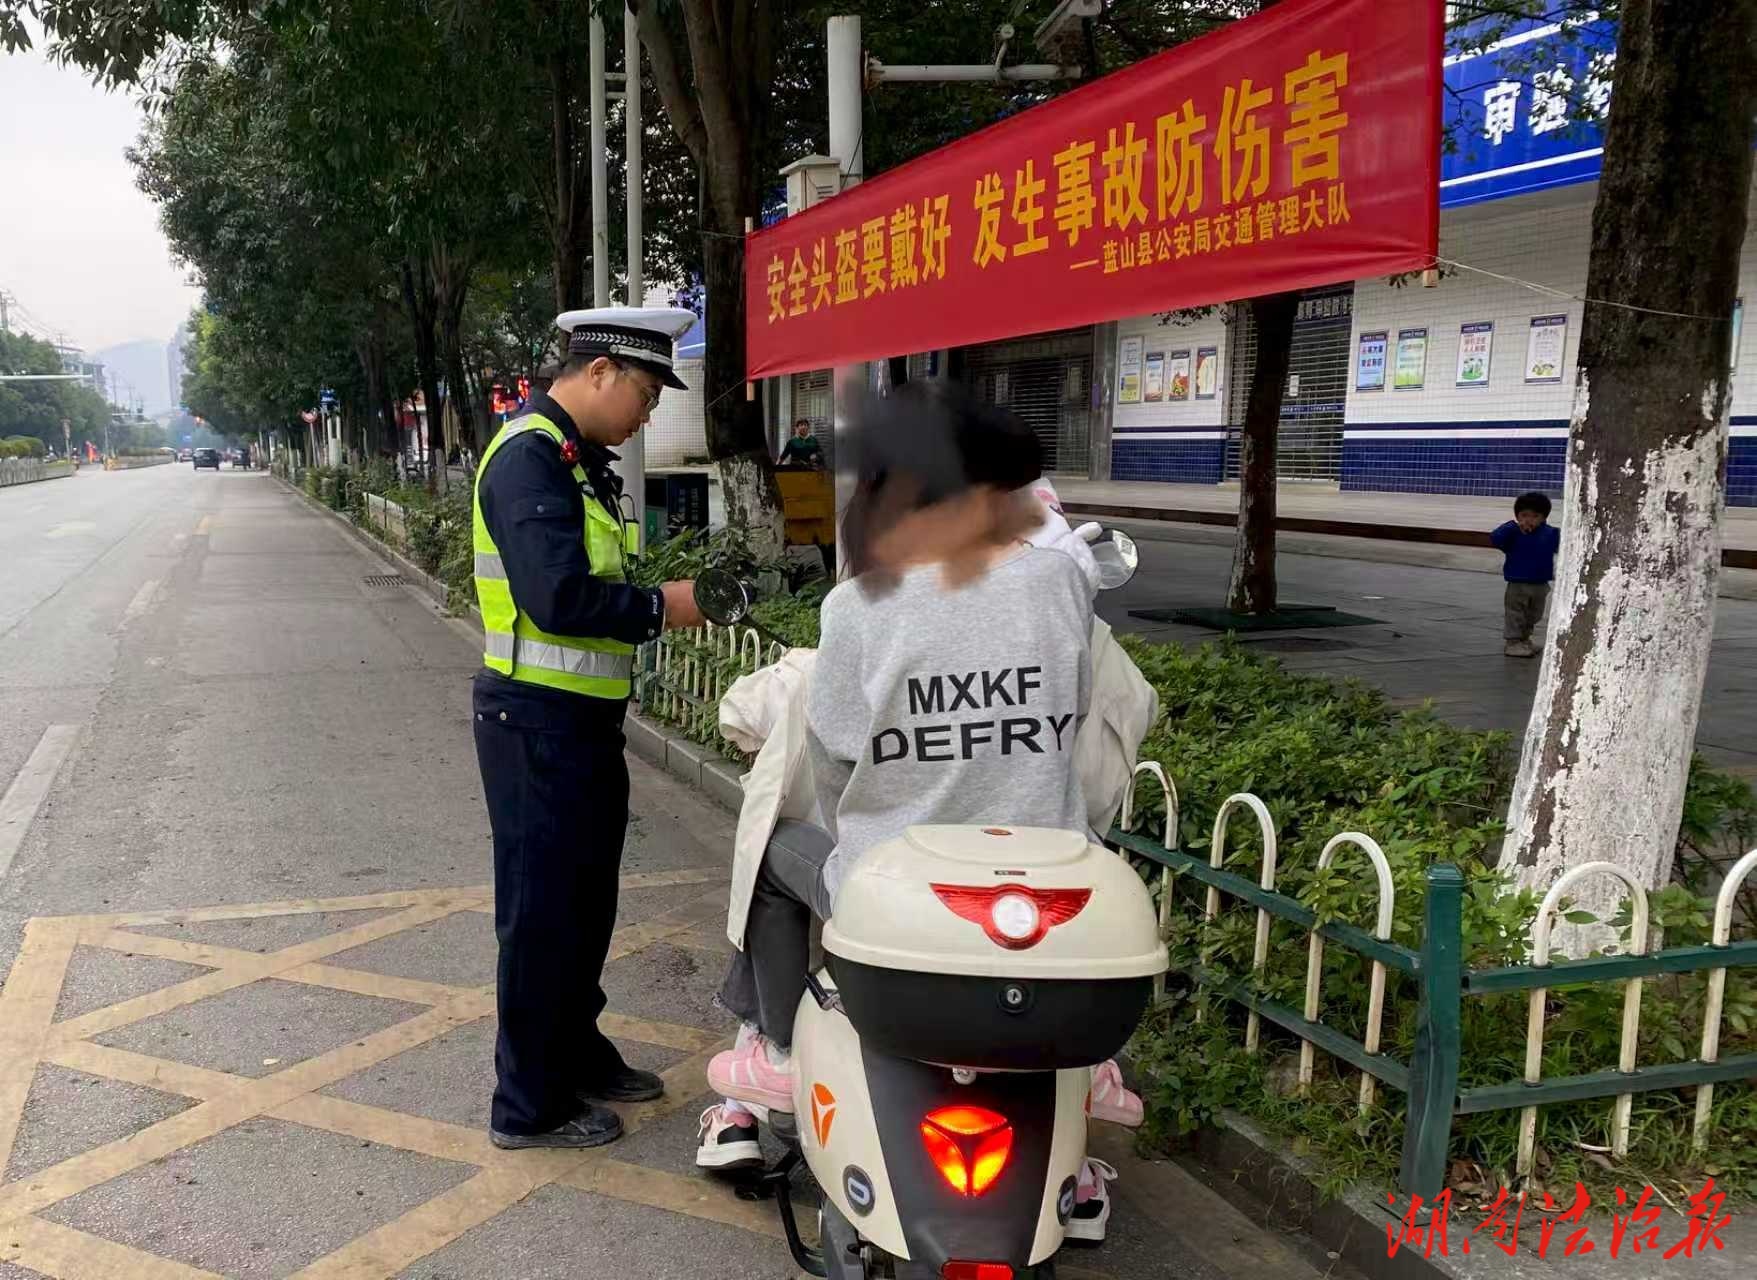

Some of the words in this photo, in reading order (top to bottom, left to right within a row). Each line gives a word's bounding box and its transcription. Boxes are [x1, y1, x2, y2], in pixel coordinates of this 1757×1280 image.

[767, 194, 952, 324] 安全头盔要戴好
[972, 50, 1349, 269] 发生事故防伤害
[908, 666, 1042, 715] MXKF
[872, 713, 1074, 765] DEFRY
